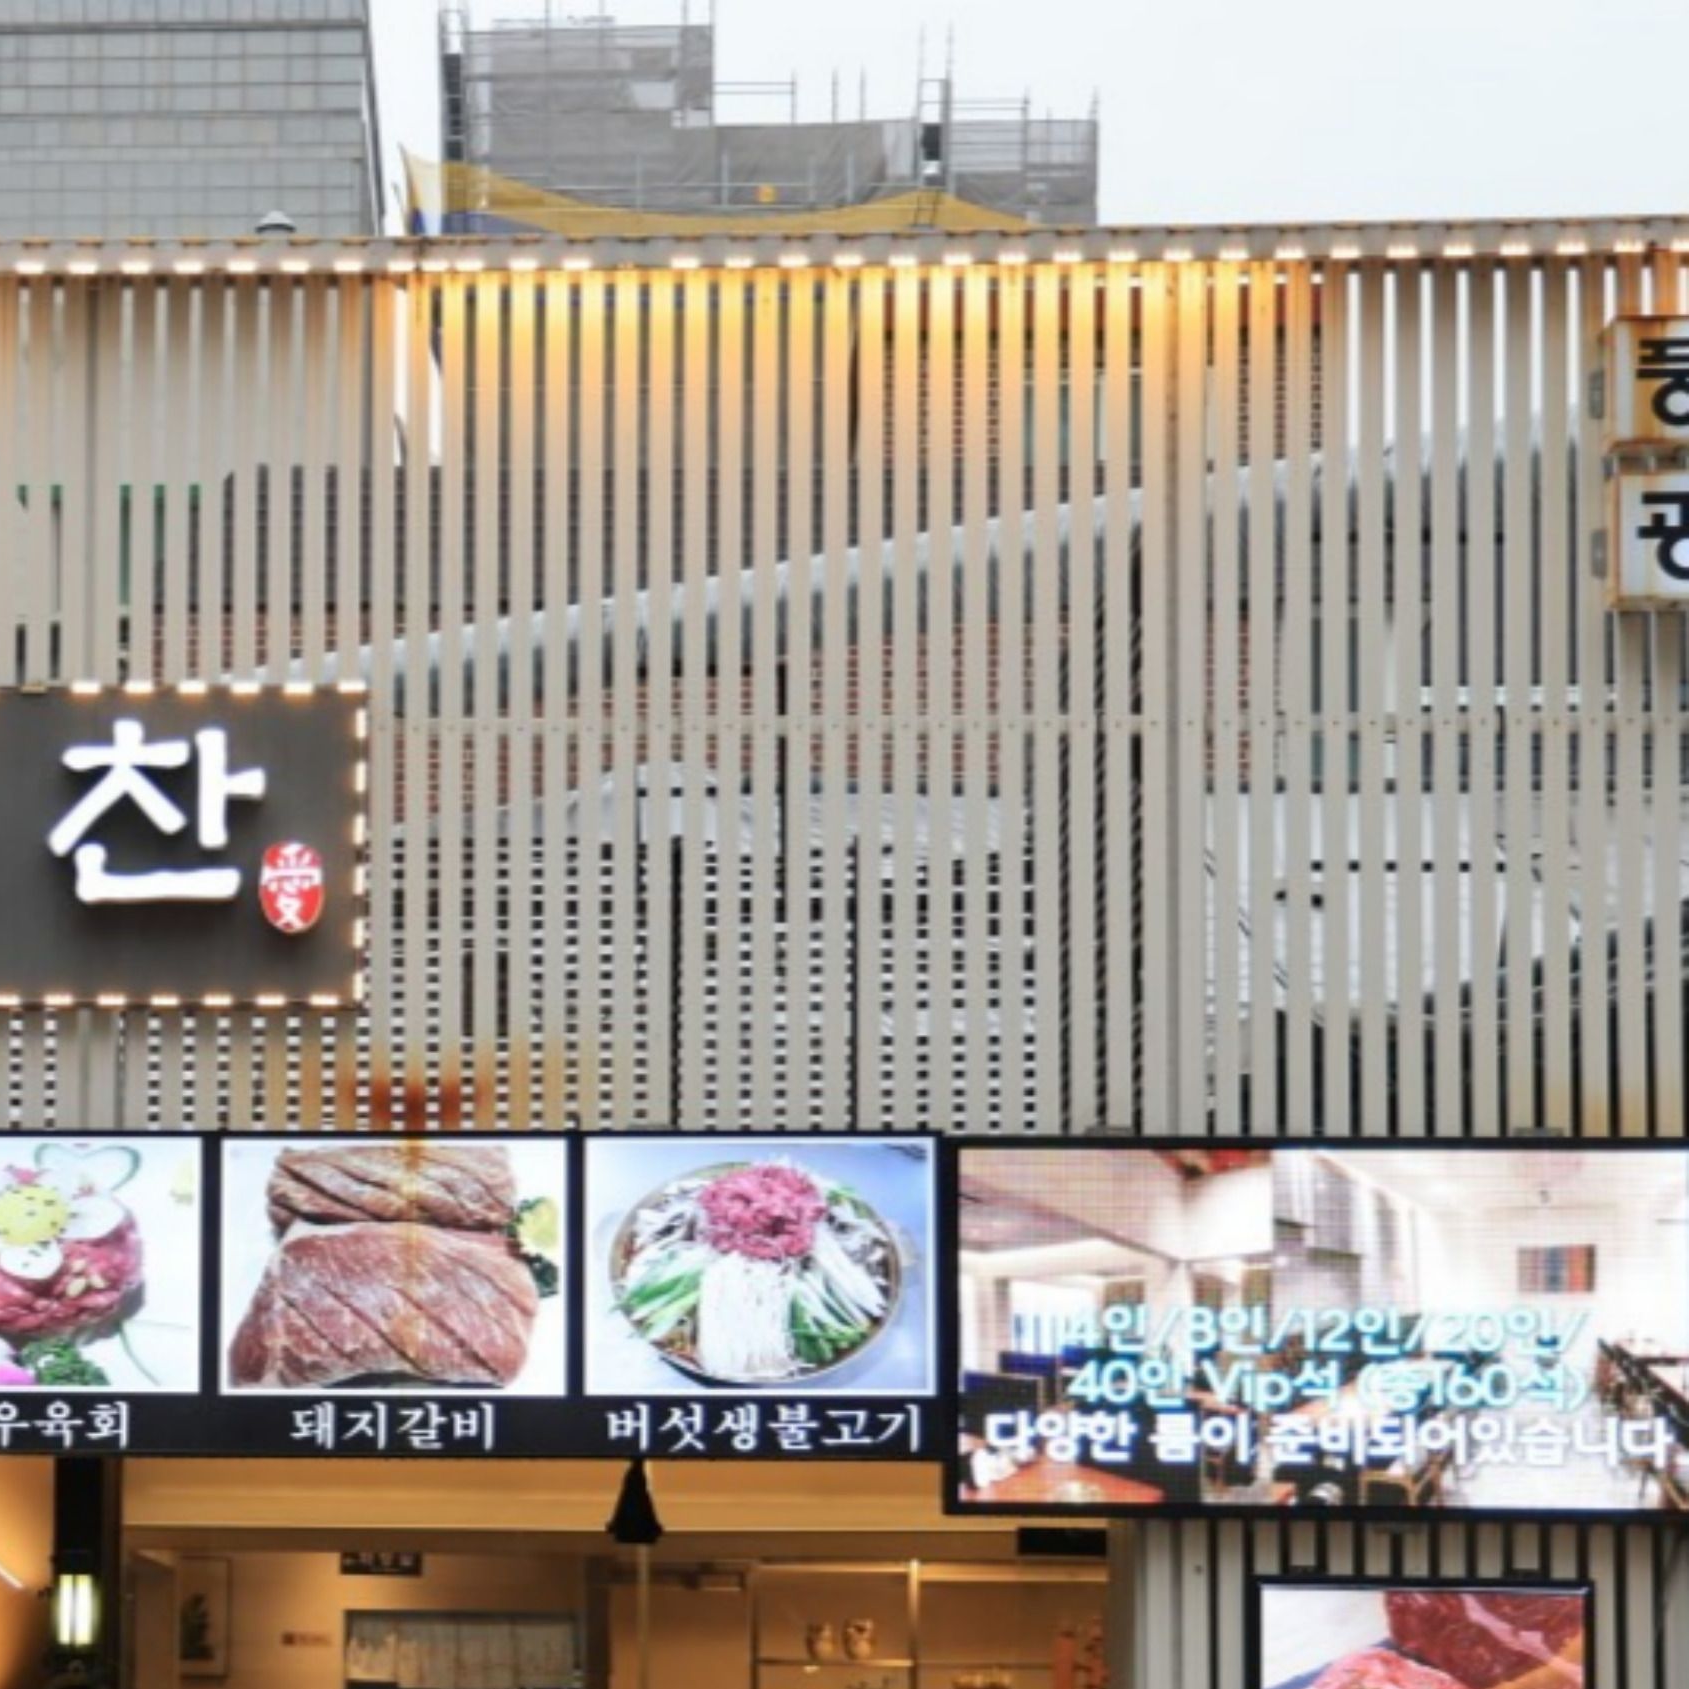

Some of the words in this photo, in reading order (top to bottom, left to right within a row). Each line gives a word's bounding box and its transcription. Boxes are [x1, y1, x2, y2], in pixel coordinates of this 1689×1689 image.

[289, 1401, 497, 1450] 돼지갈비
[604, 1402, 922, 1453] 버섯생불고기
[983, 1410, 1138, 1464] 다양한
[1265, 1411, 1674, 1468] 준비되어있습니다
